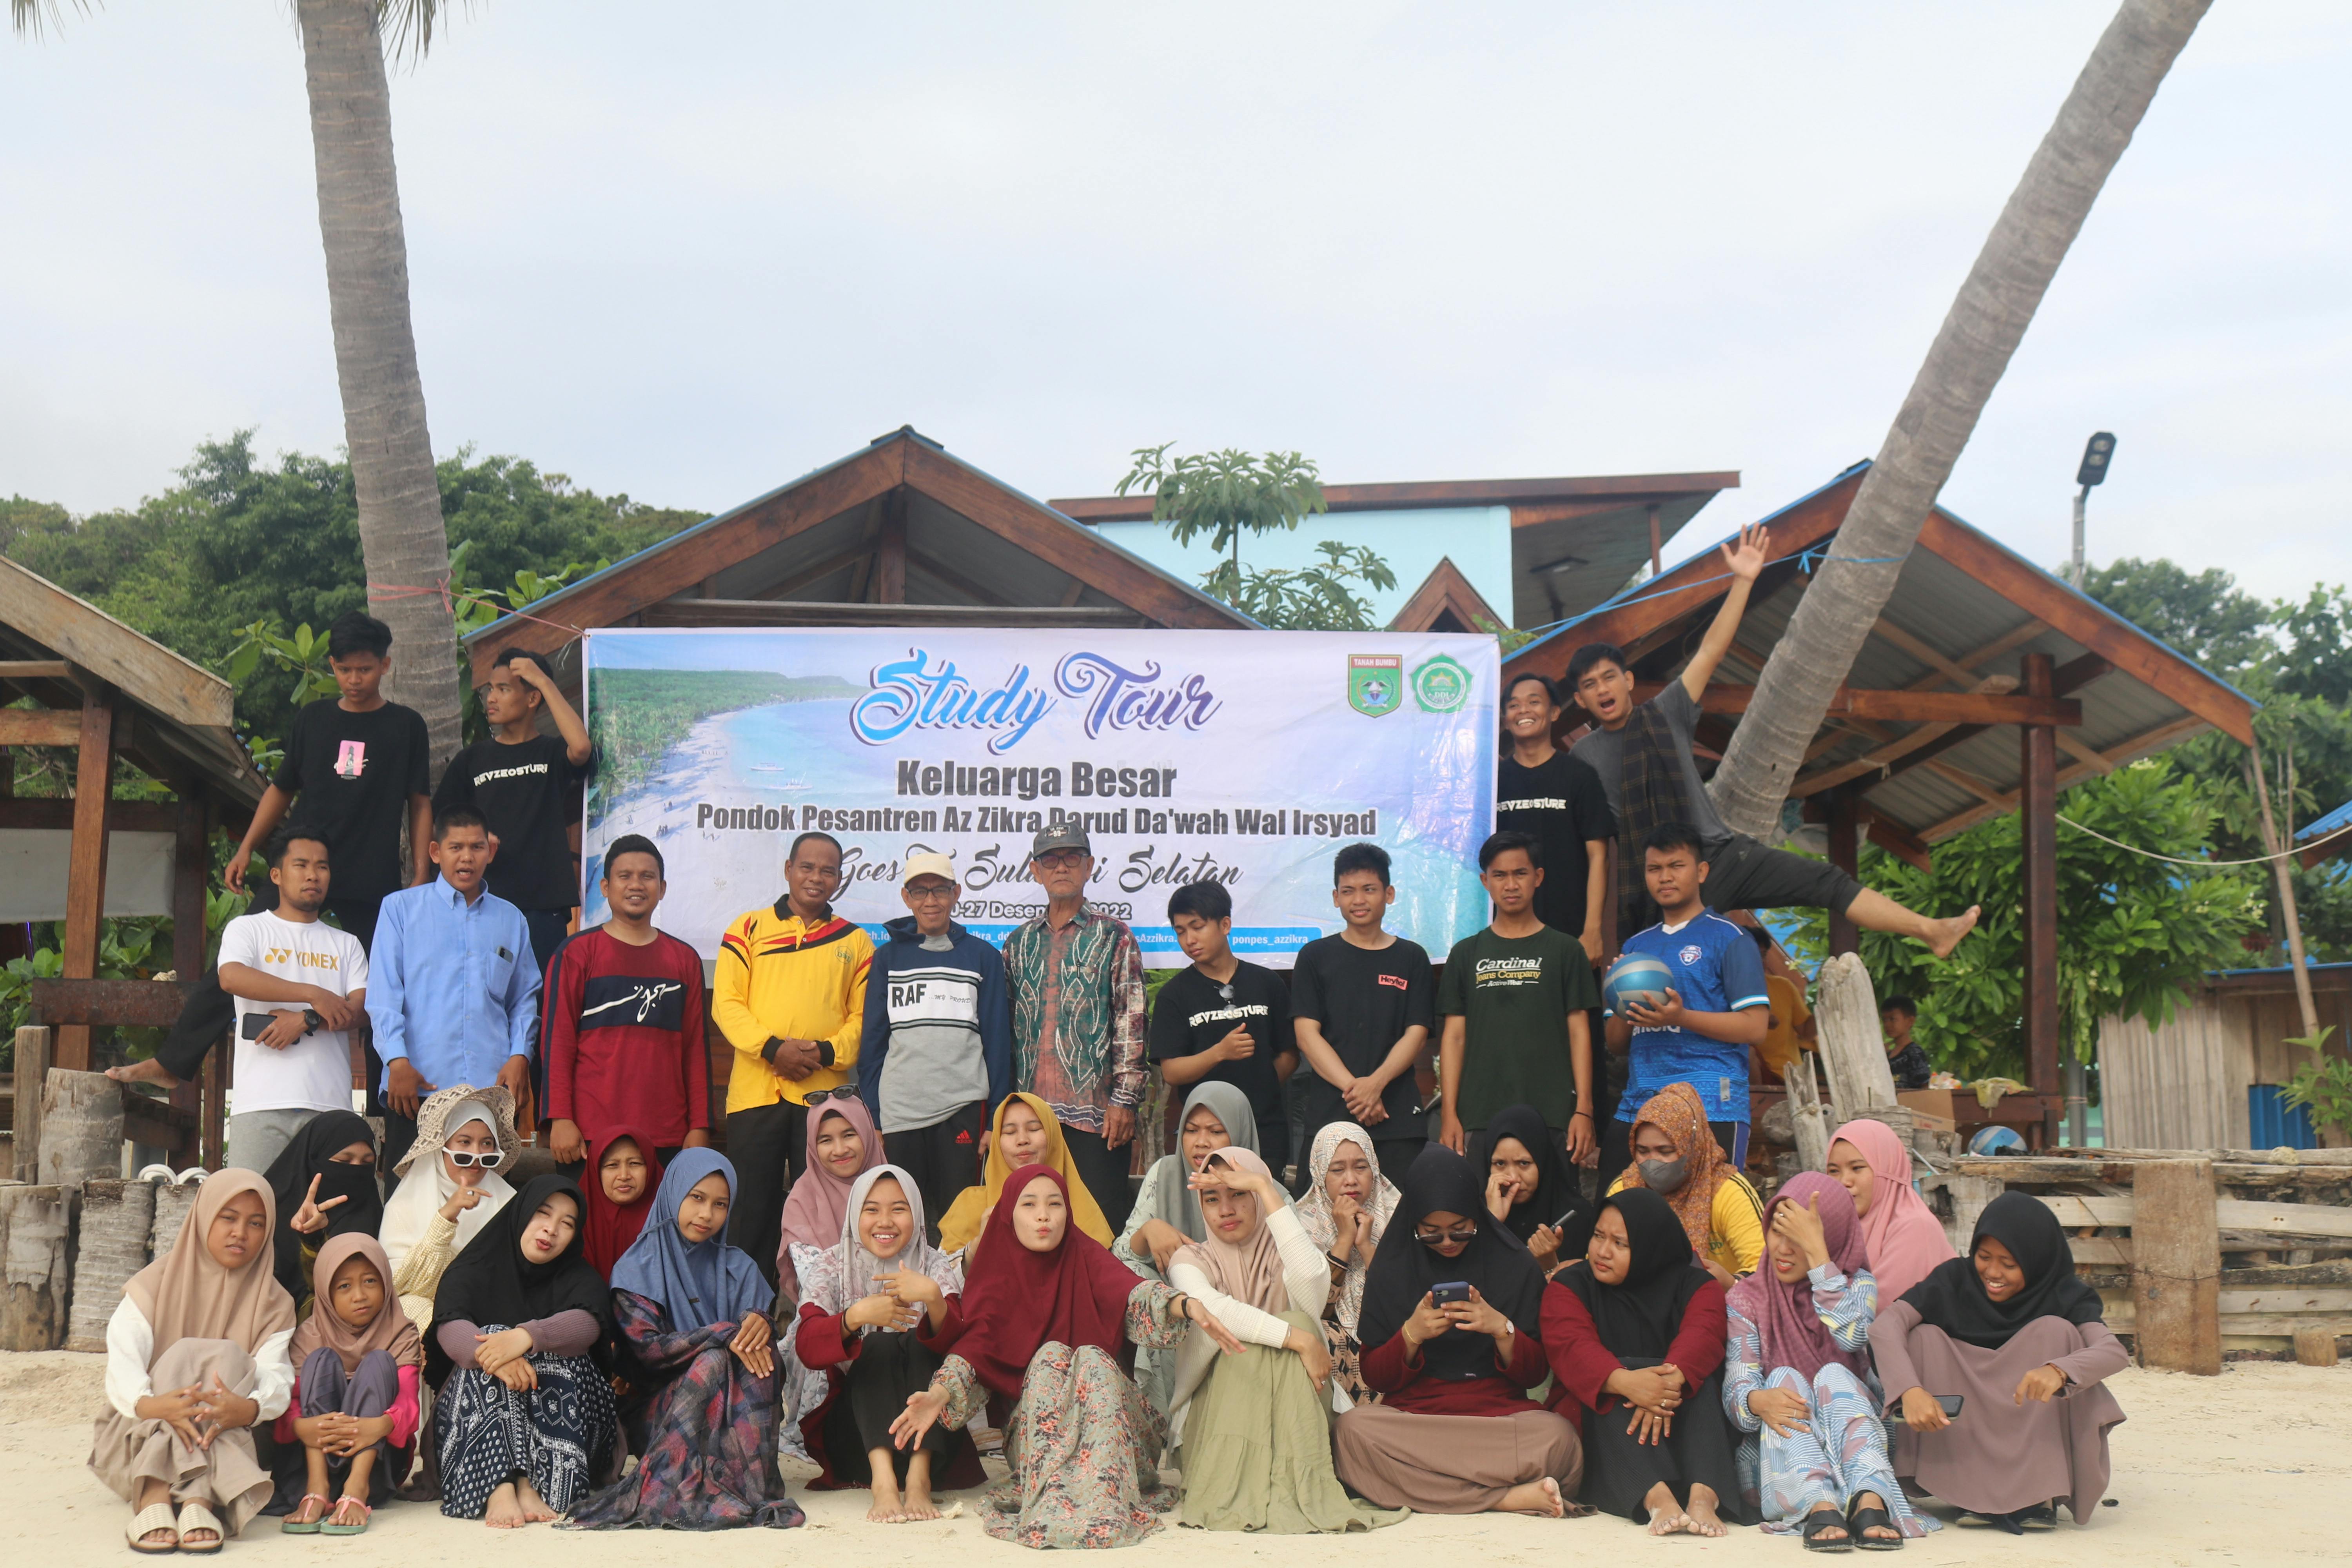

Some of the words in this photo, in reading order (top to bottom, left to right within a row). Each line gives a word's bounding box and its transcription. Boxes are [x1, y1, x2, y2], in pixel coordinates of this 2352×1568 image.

[849, 647, 1058, 755] Study
[1054, 652, 1223, 740] Tour
[898, 760, 1061, 800] Keluarga
[1072, 762, 1176, 797] Besar
[697, 804, 795, 831] Pondok
[802, 805, 936, 833] Pesantren
[943, 807, 972, 832] Az
[978, 807, 1043, 833] Zikra
[1135, 808, 1228, 834] Da'wah
[1235, 809, 1286, 835] Wal
[1294, 810, 1376, 838] Irsyad
[1119, 844, 1244, 893] Selatan
[1232, 935, 1308, 946] ponpes_azzikra
[295, 950, 339, 971] YONEX
[1476, 957, 1543, 971] Cardinal
[1476, 972, 1496, 984] Jeans
[1497, 970, 1541, 980] Company
[892, 984, 927, 1008] RAF
